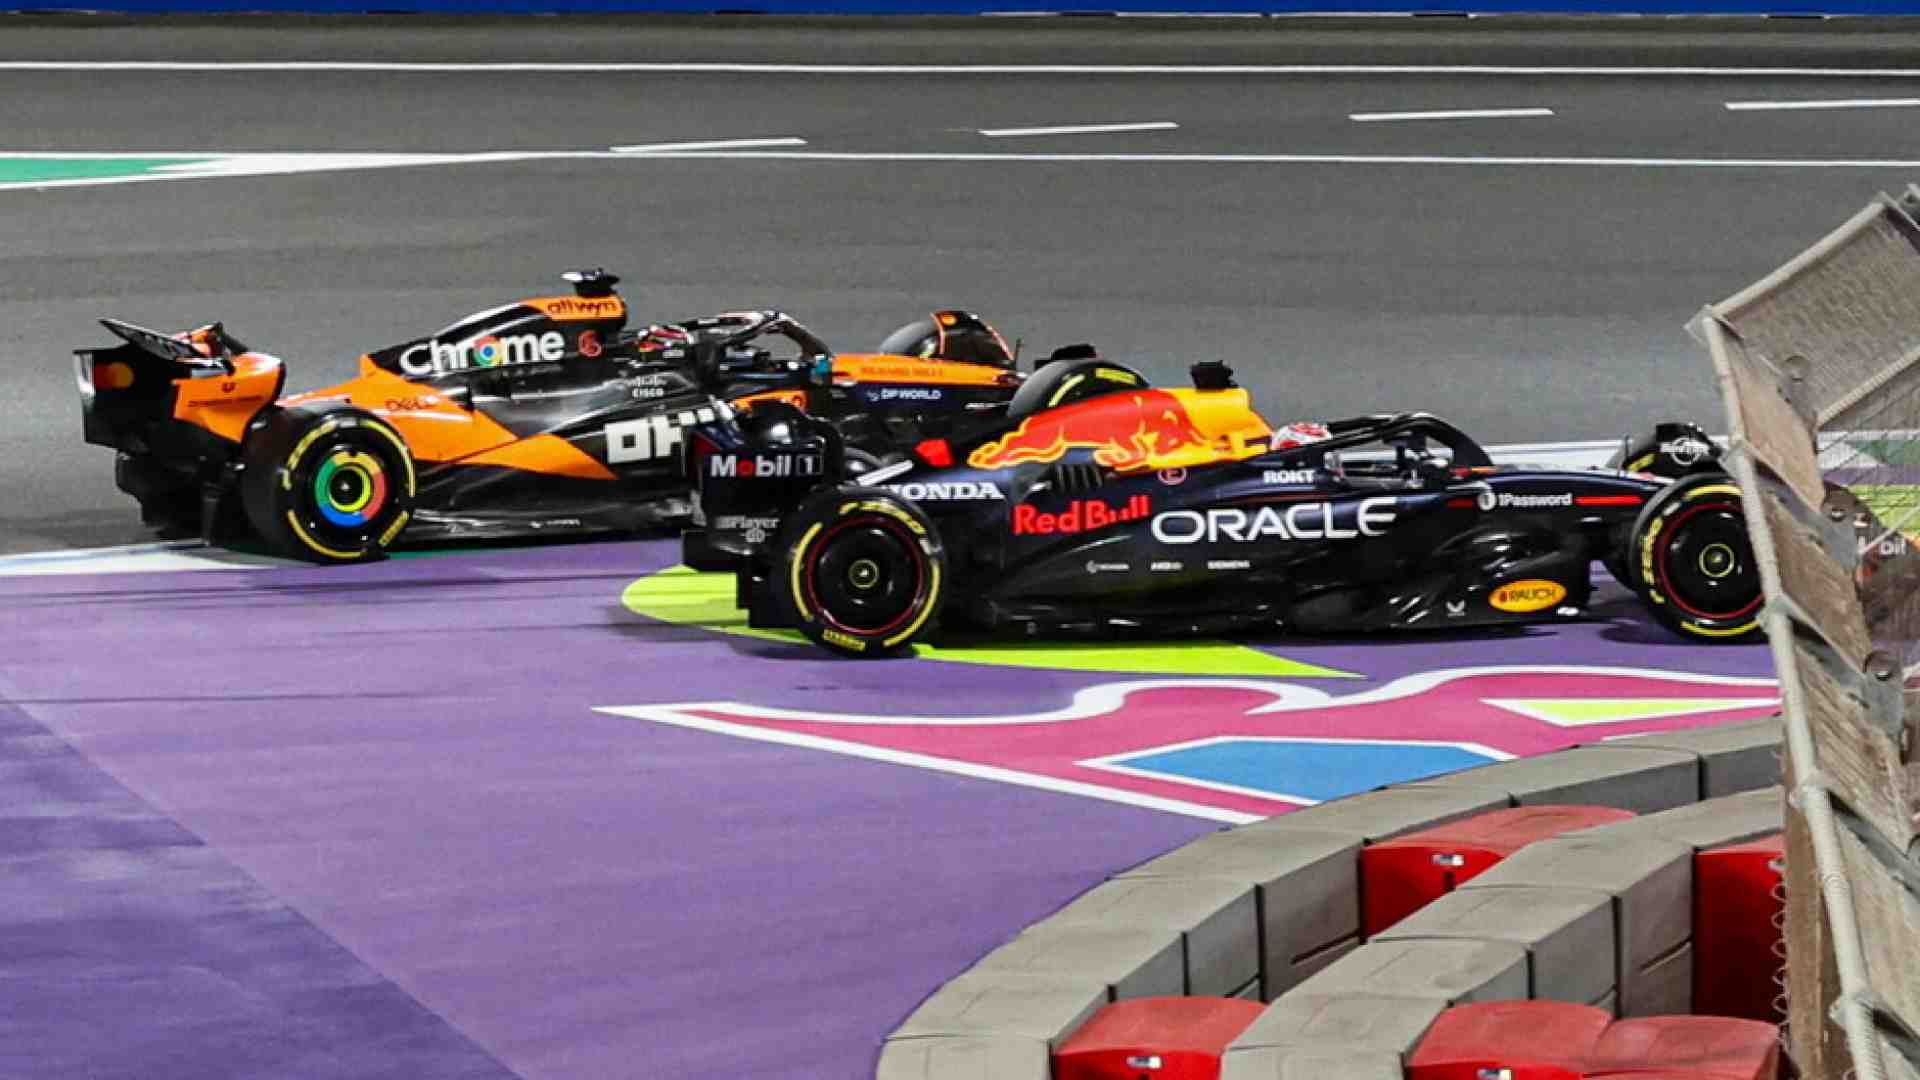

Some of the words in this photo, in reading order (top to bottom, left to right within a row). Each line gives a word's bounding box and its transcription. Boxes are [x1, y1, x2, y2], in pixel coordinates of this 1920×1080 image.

[400, 331, 565, 375] Chrome
[899, 388, 942, 400] WORLD
[711, 455, 792, 477] Mobil
[1499, 492, 1573, 507] 1Password
[1014, 502, 1080, 535] Red
[1151, 496, 1398, 544] ORACLE
